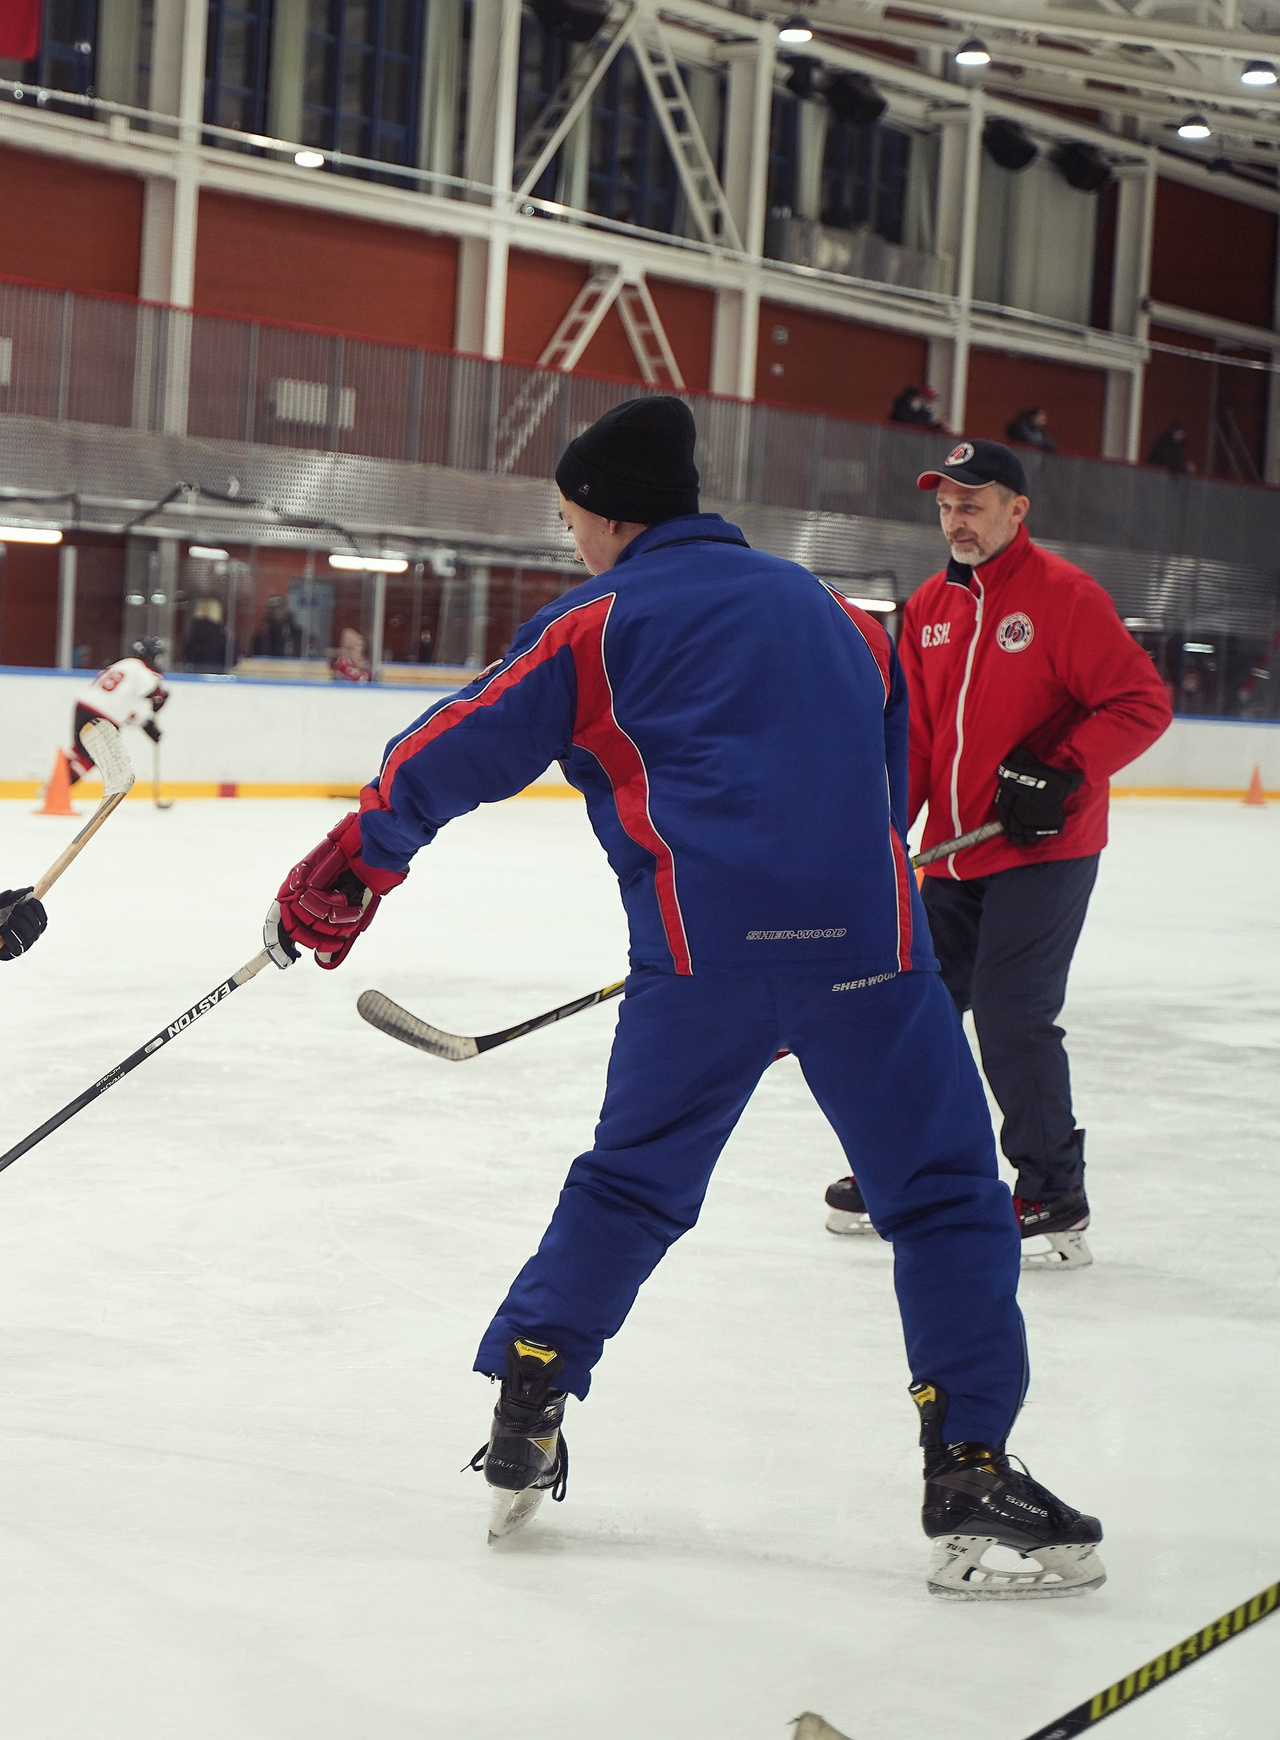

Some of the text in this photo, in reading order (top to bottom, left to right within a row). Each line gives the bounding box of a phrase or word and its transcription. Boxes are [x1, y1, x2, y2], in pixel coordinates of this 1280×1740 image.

[746, 927, 847, 941] SHER-WOOD
[831, 972, 897, 993] SHER-WOOD
[167, 982, 231, 1039] EASTON
